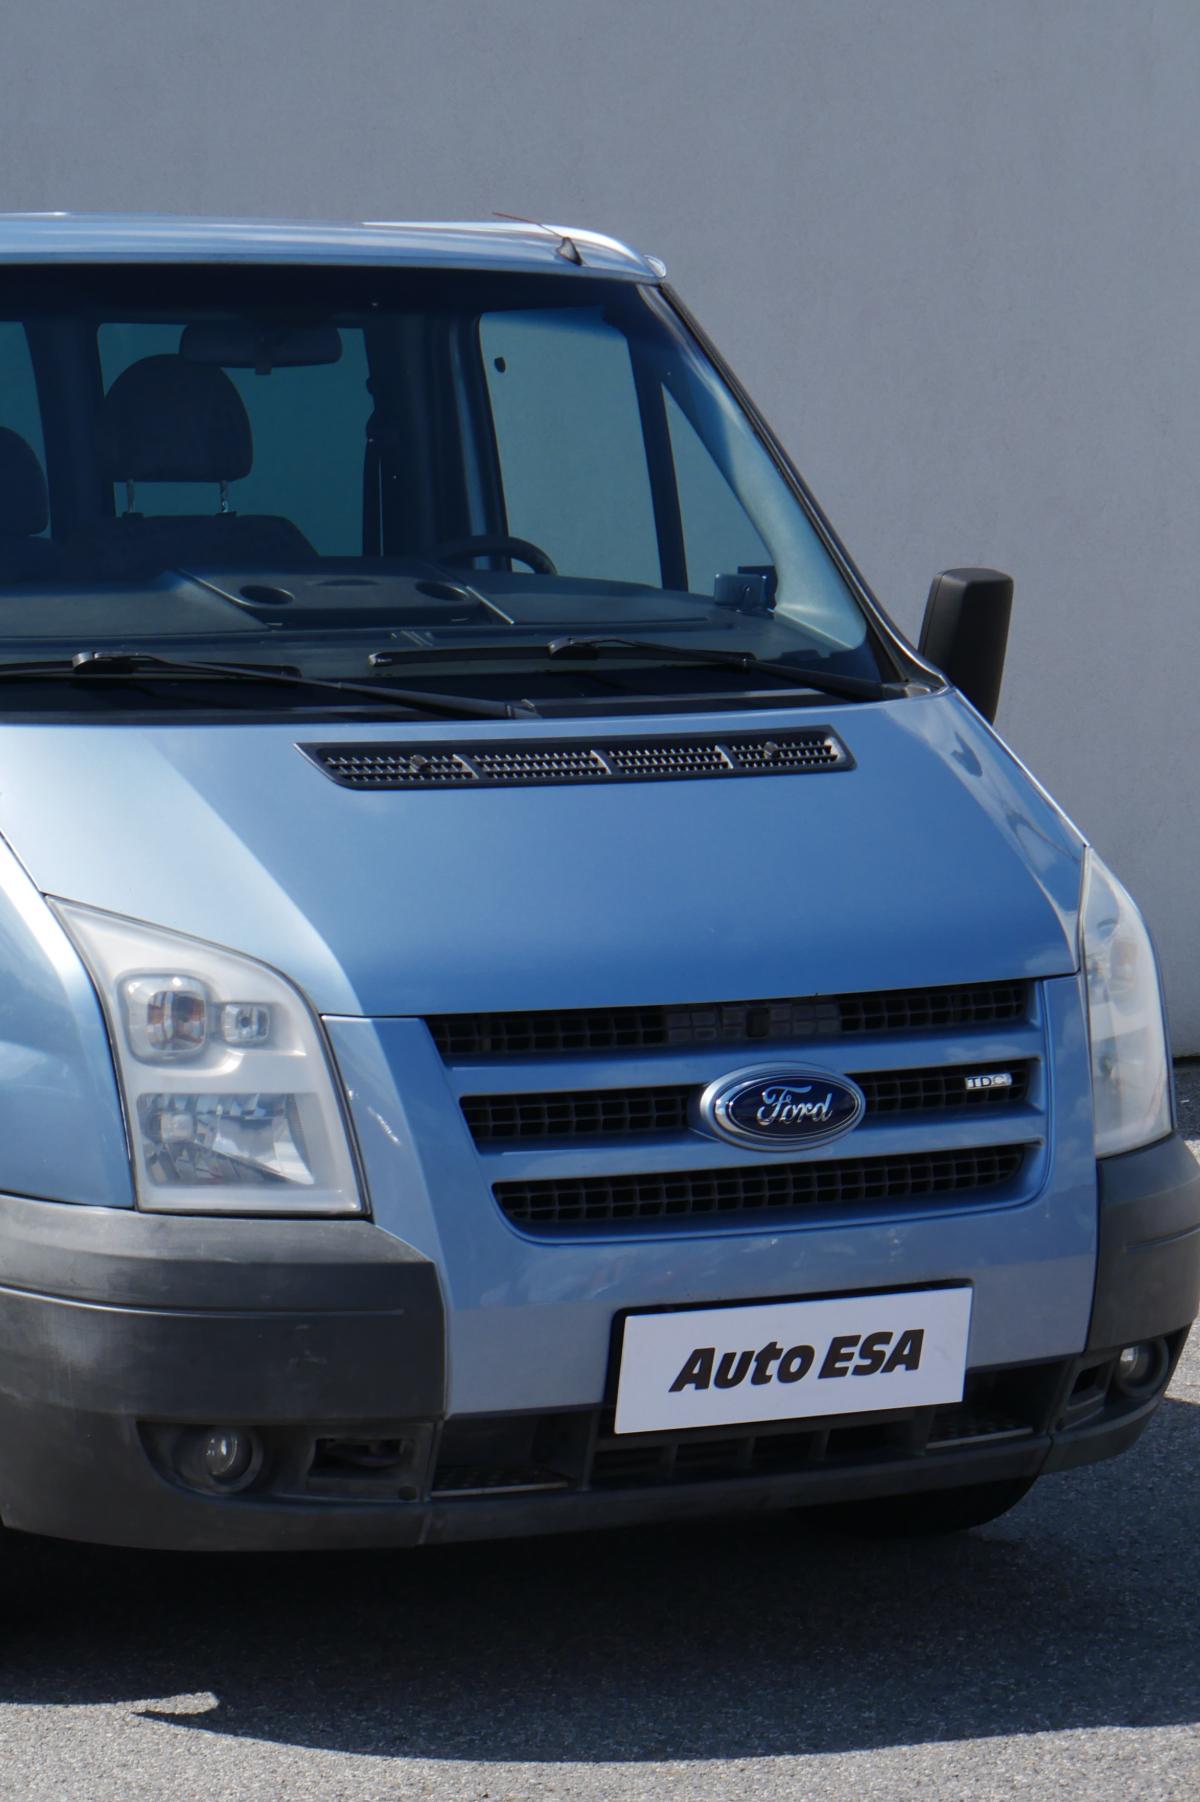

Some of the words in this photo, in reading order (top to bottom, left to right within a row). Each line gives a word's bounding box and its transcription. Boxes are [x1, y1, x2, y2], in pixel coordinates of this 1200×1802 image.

[756, 1085, 833, 1126] Ford
[668, 1341, 815, 1393] Auto
[817, 1328, 925, 1379] ESA
